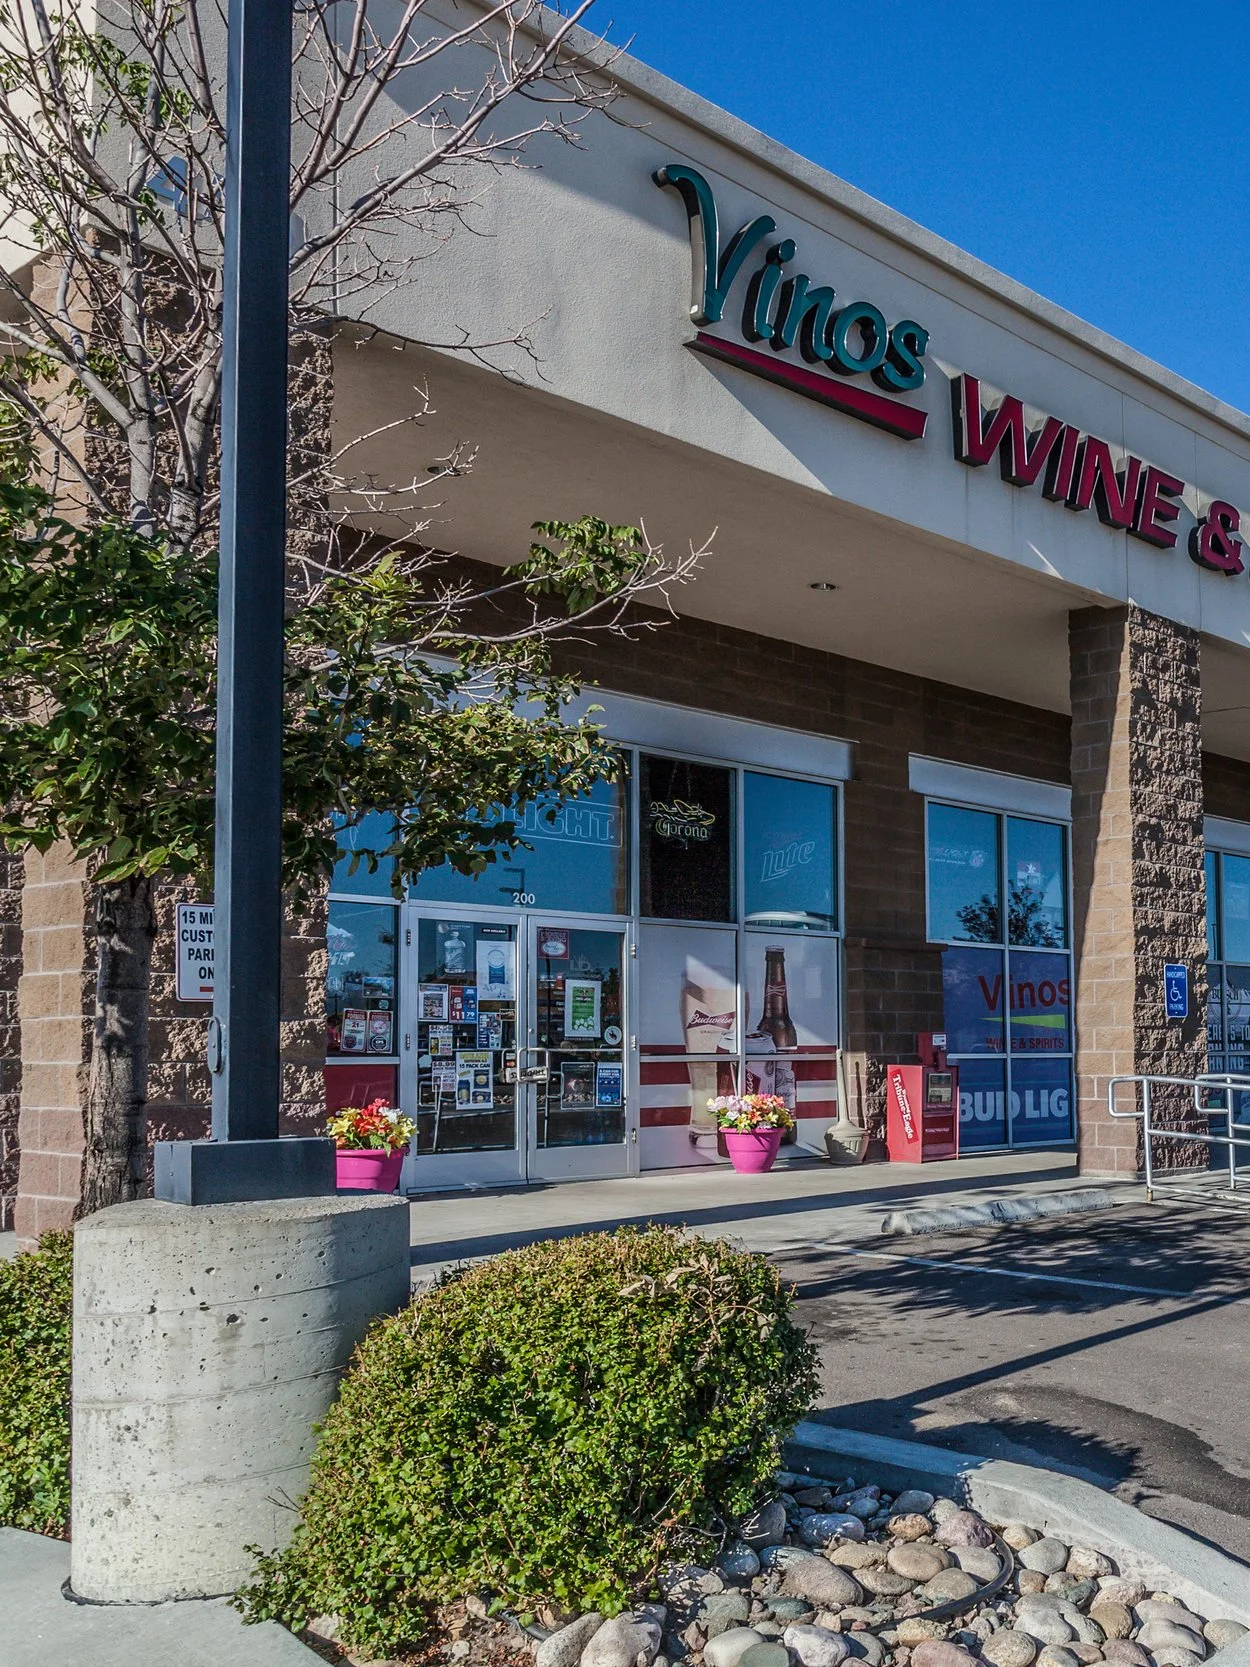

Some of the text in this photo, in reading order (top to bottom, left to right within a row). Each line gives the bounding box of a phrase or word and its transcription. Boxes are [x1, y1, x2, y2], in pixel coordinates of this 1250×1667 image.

[652, 164, 931, 394] Vinos
[951, 373, 1185, 549] WINE
[1188, 500, 1245, 577] &
[655, 818, 708, 839] Corona
[512, 892, 535, 904] 200
[182, 911, 214, 925] 15 MI
[181, 929, 214, 943] CUST
[978, 974, 1072, 1011] Vinos
[691, 1013, 733, 1025] Budweise
[1241, 1024, 1250, 1040] TO
[1018, 1038, 1026, 1049] &
[1029, 1037, 1065, 1049] SPIRITS
[892, 1073, 914, 1140] Tribune-Eagle
[960, 1091, 1021, 1122] BUD
